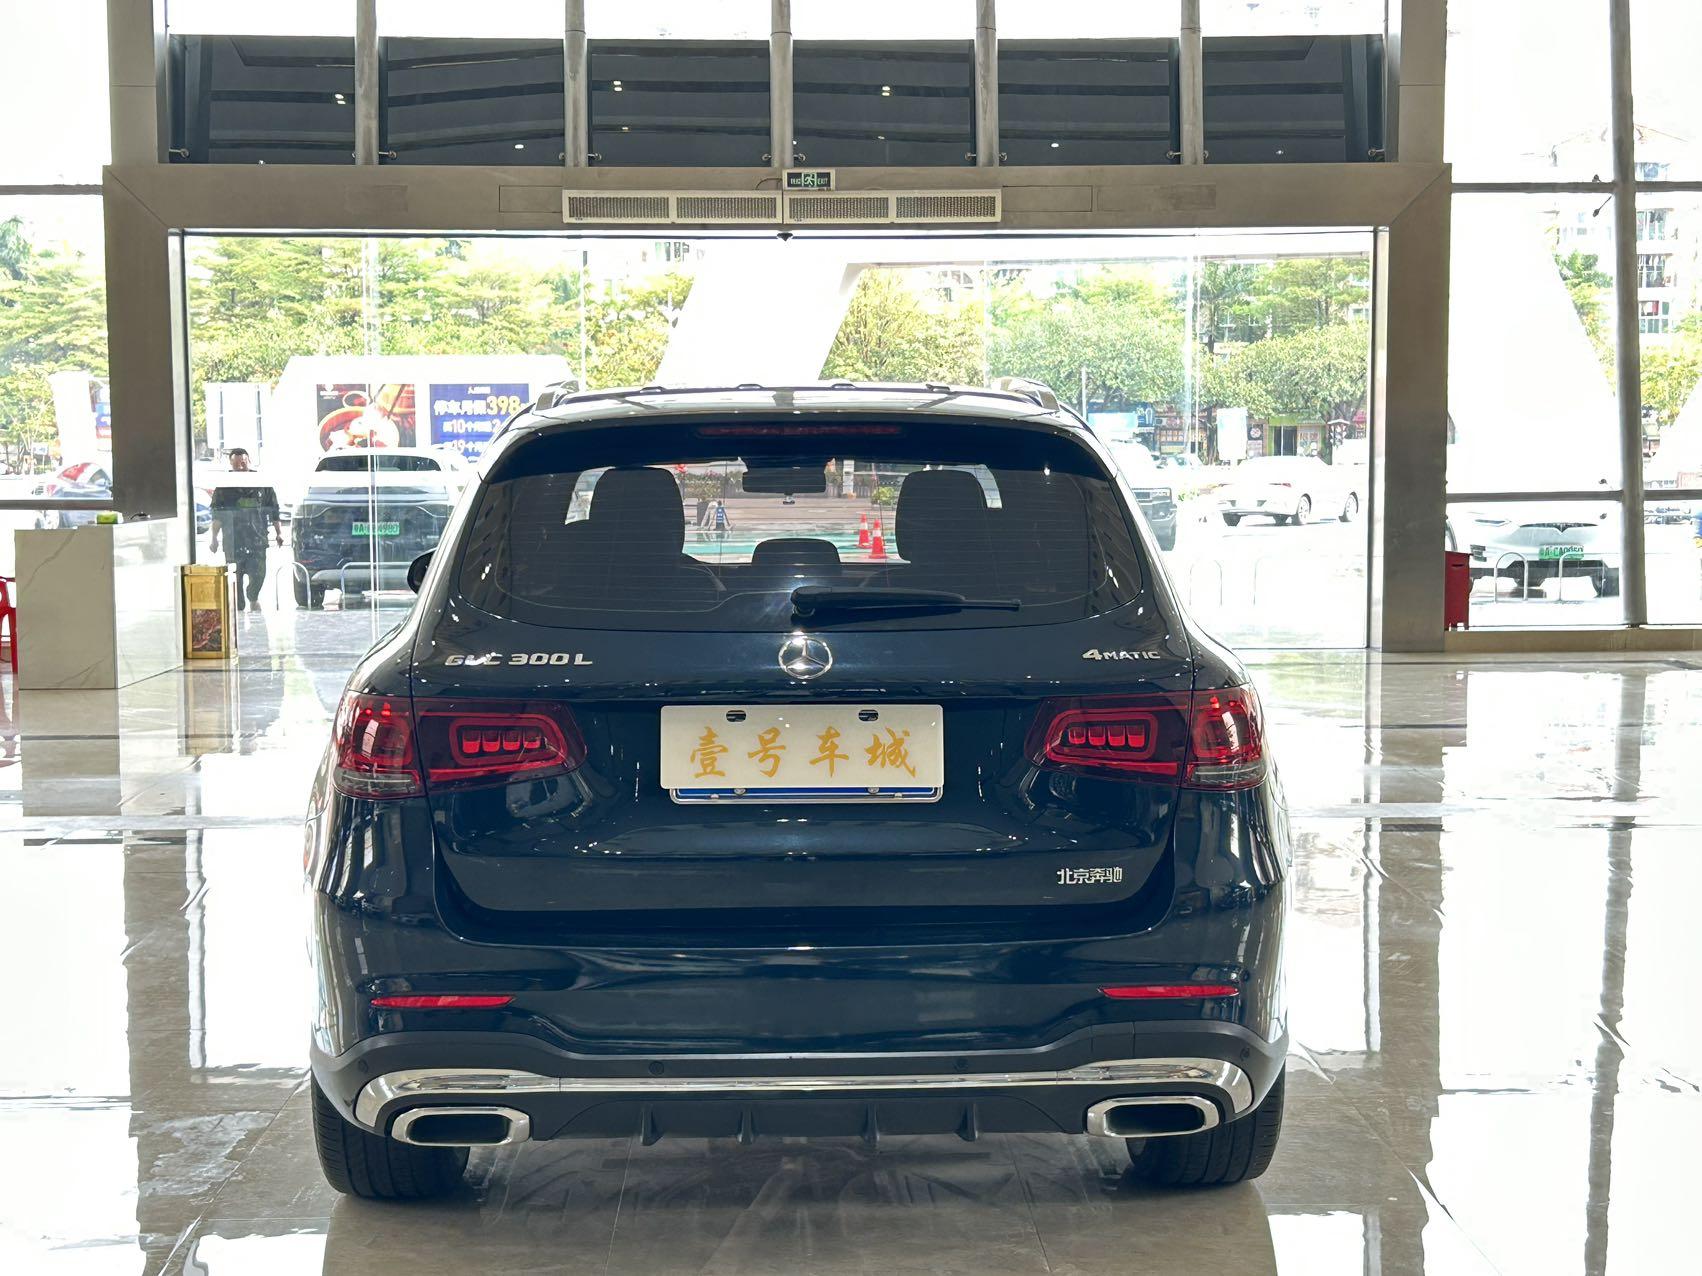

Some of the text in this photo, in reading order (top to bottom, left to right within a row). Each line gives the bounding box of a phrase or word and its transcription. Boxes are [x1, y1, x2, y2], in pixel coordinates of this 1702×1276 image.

[445, 652, 503, 666] GLC
[1082, 649, 1161, 660] 4MATIC
[690, 726, 916, 779] 壹号车城
[1056, 867, 1123, 885] 北京奔驰
